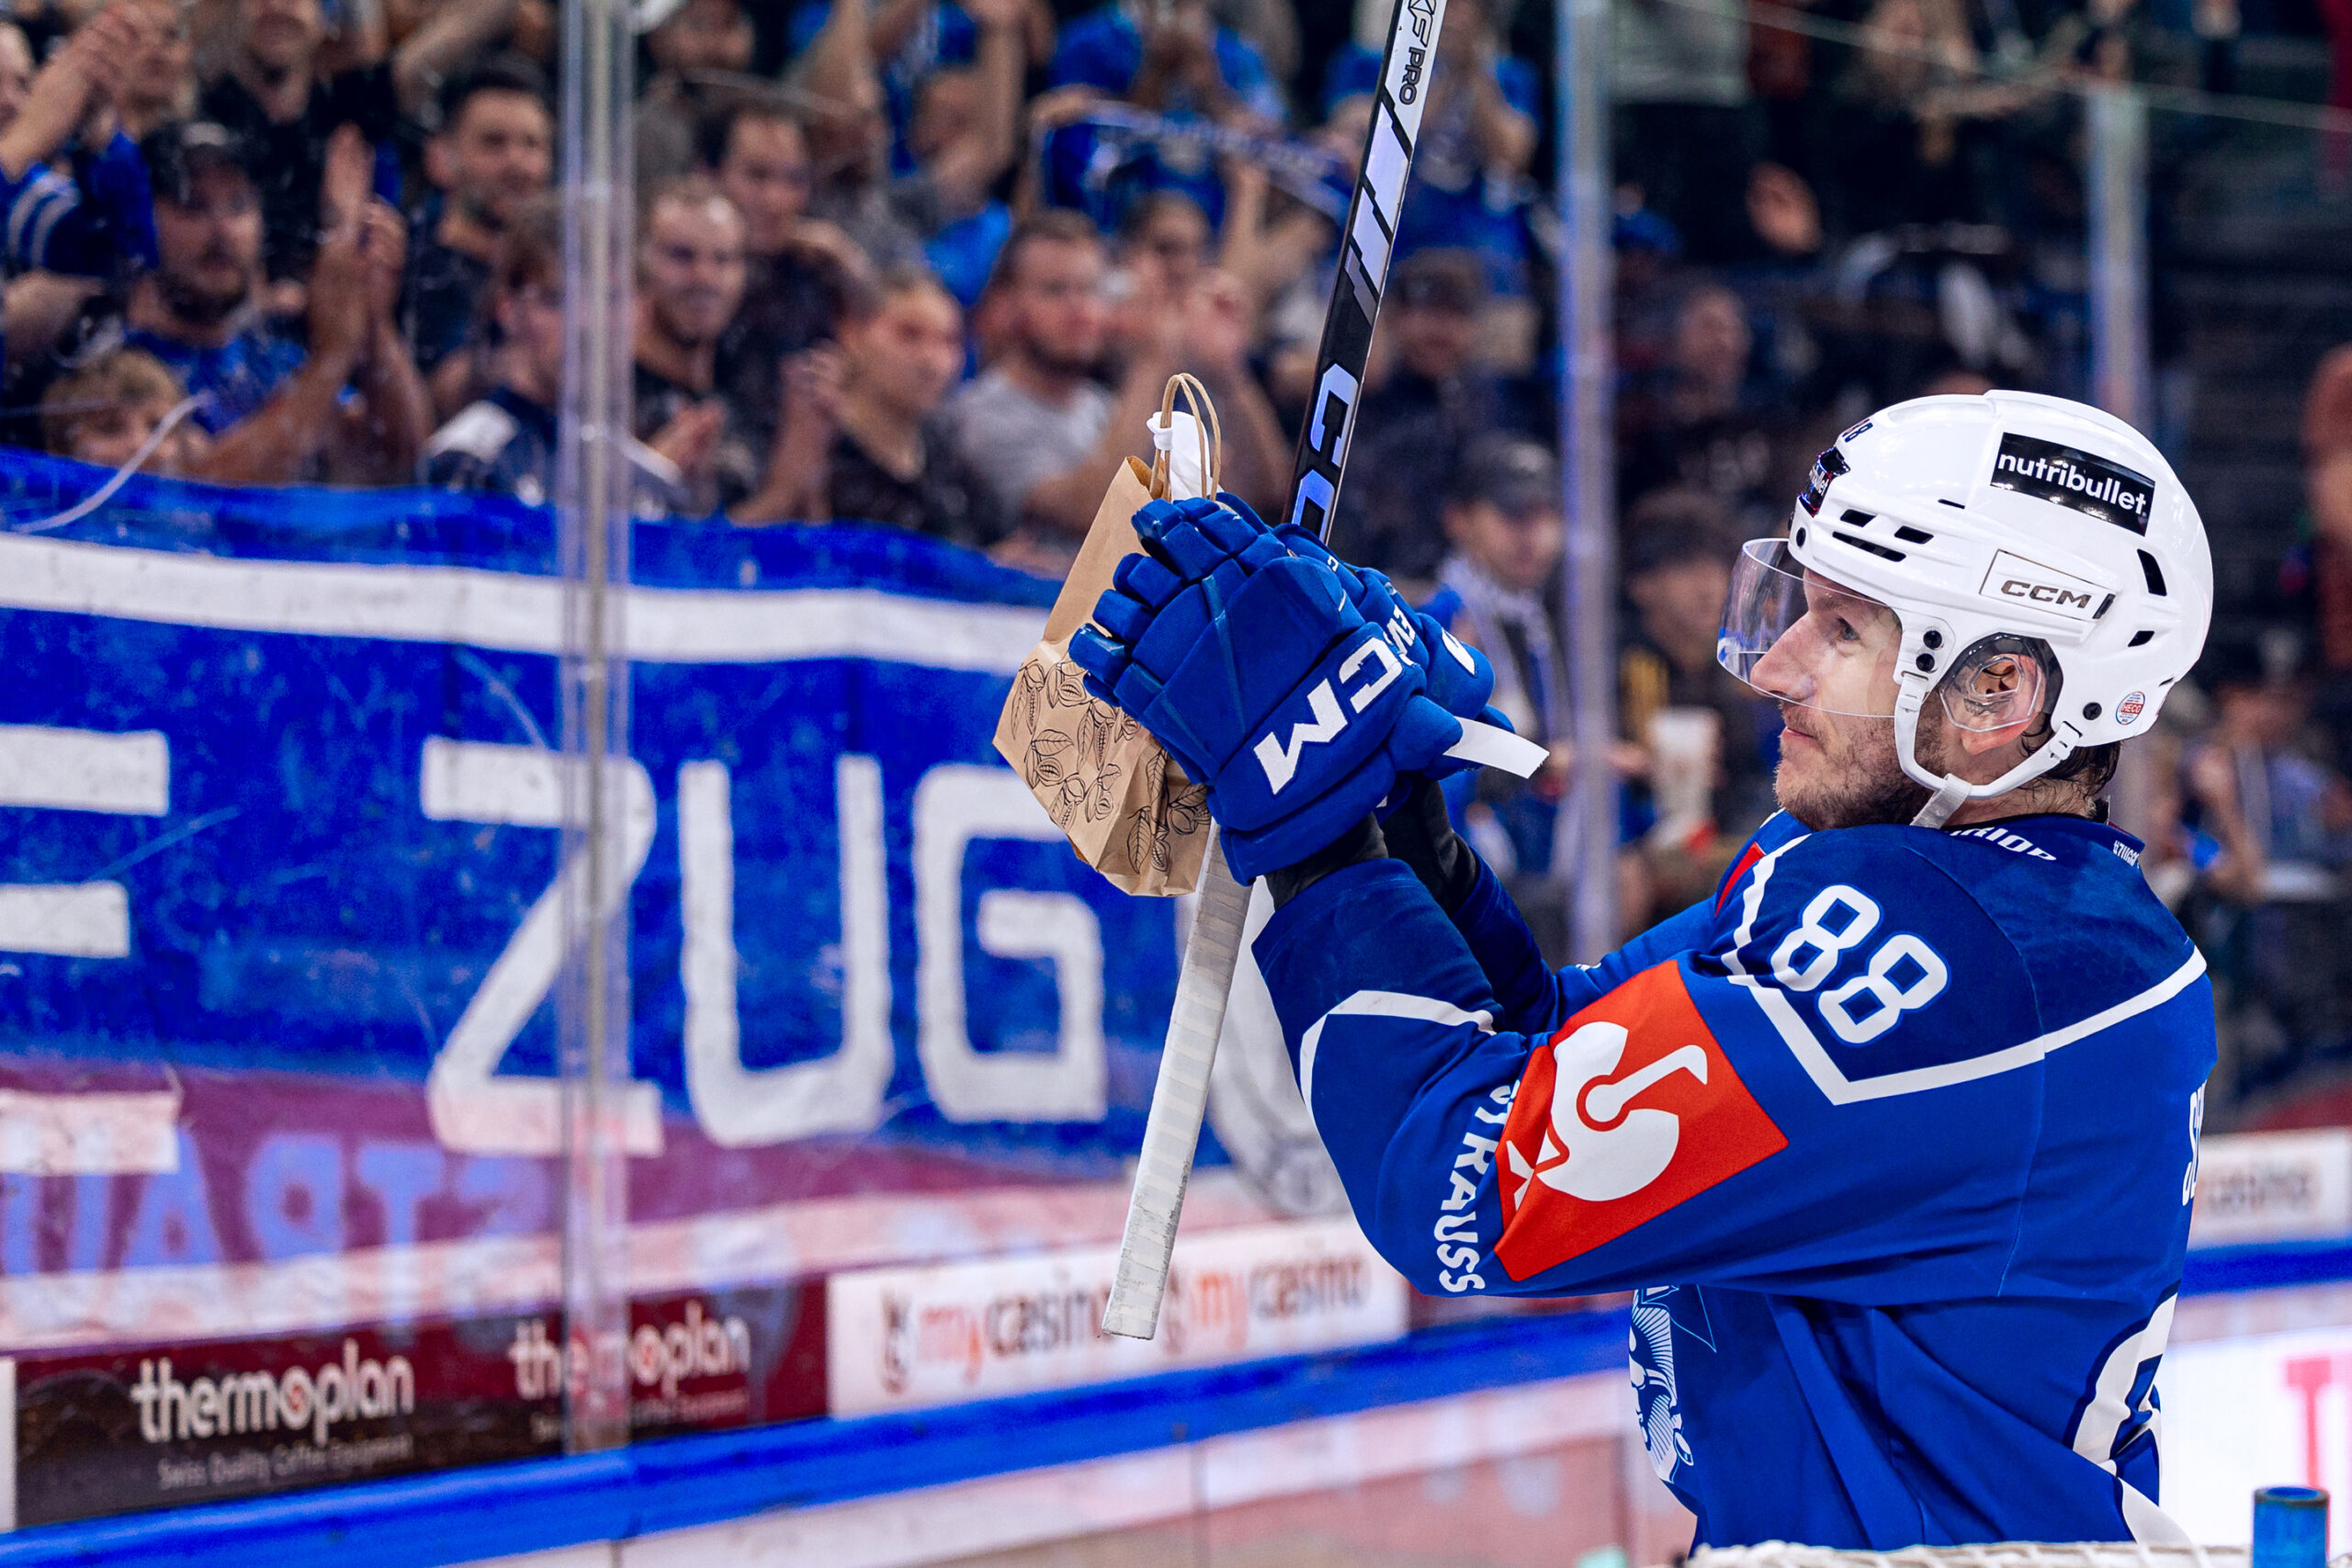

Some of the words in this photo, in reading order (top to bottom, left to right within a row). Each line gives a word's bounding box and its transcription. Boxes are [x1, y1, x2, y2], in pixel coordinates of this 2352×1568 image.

[1398, 47, 1426, 106] PRO
[1997, 453, 2147, 517] nutribullet
[2000, 580, 2092, 609] CCM
[1252, 629, 1415, 795] CM
[420, 735, 1107, 1155] ZUG
[1770, 884, 1950, 1045] 88
[508, 1299, 751, 1403] theoplan
[919, 1271, 1114, 1383] mycasin
[130, 1337, 414, 1447] thermoplan
